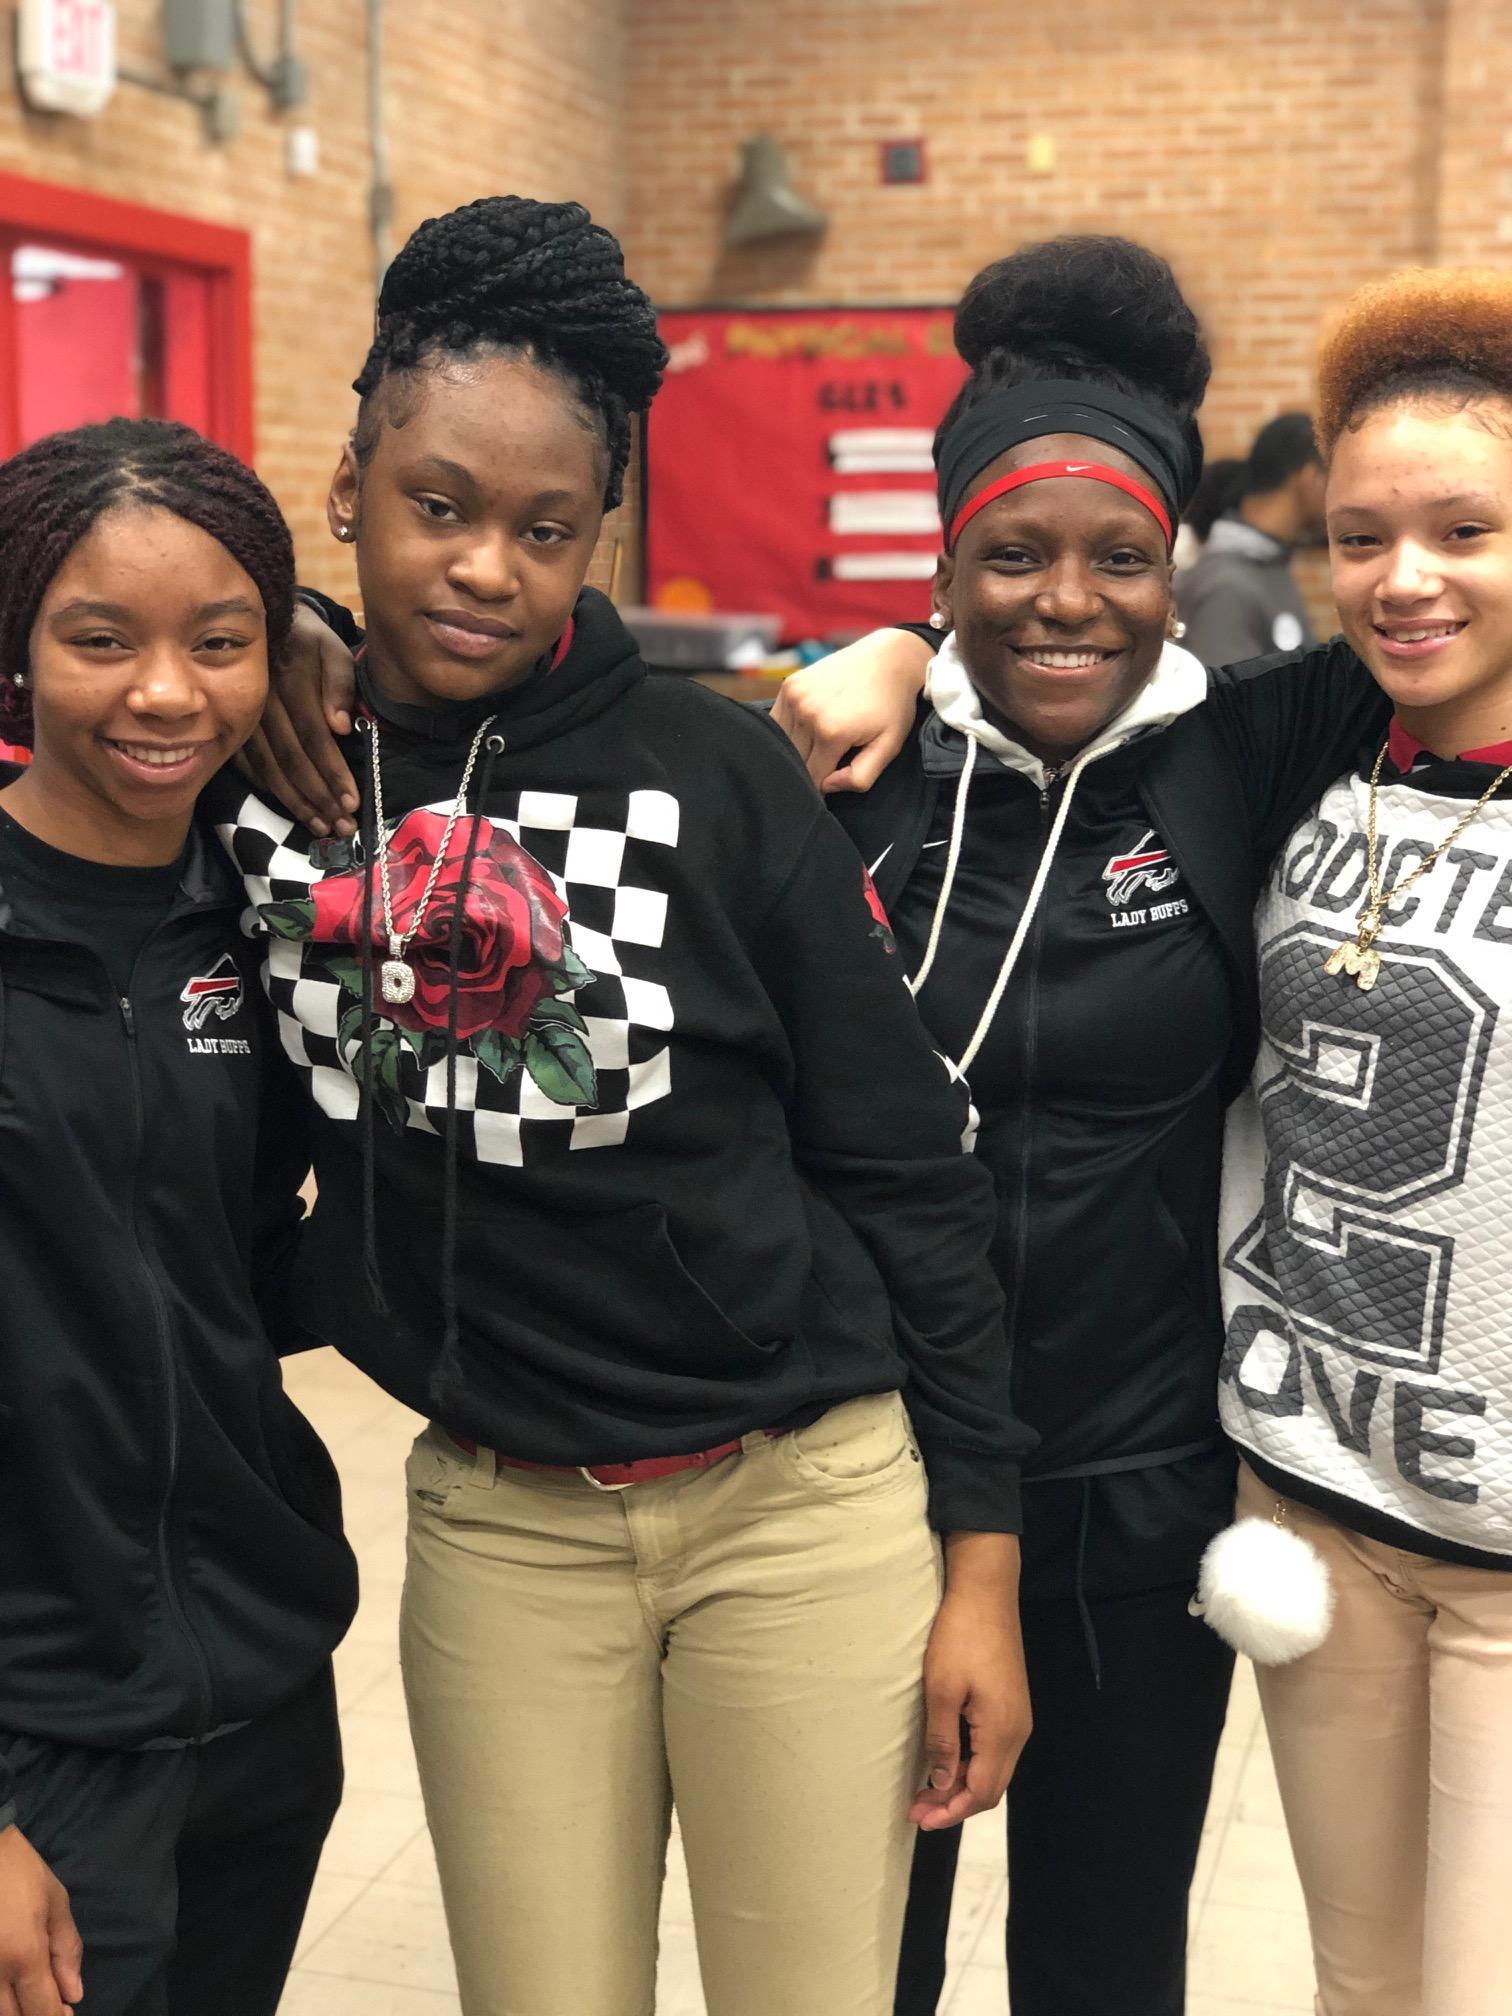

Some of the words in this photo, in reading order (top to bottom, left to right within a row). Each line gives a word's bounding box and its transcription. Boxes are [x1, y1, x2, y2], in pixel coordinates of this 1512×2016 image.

[1110, 909, 1147, 928] LADY
[1149, 899, 1189, 921] BUFFS
[187, 1038, 218, 1054] LADY
[220, 1039, 251, 1054] BUFFS
[1224, 921, 1499, 1375] 2
[1219, 1305, 1487, 1504] OVE
